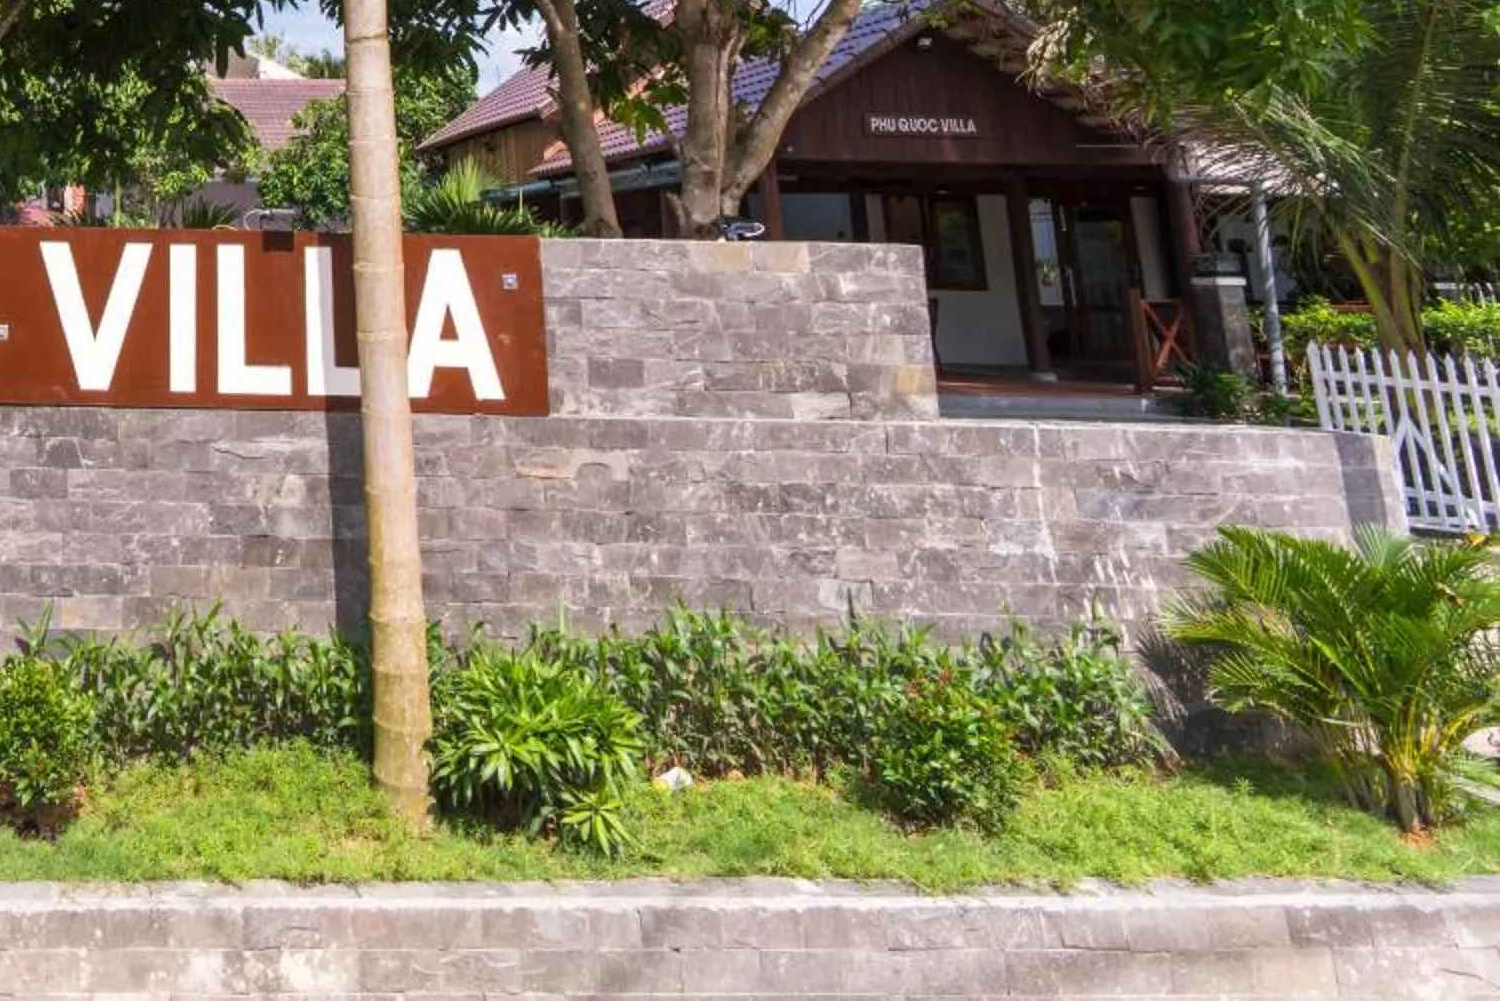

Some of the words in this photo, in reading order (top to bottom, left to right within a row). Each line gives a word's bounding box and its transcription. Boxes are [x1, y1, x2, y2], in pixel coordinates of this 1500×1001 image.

[870, 116, 896, 132] PHU
[898, 117, 937, 133] QUOC
[940, 118, 977, 134] VILLA
[39, 241, 504, 400] VILLA
